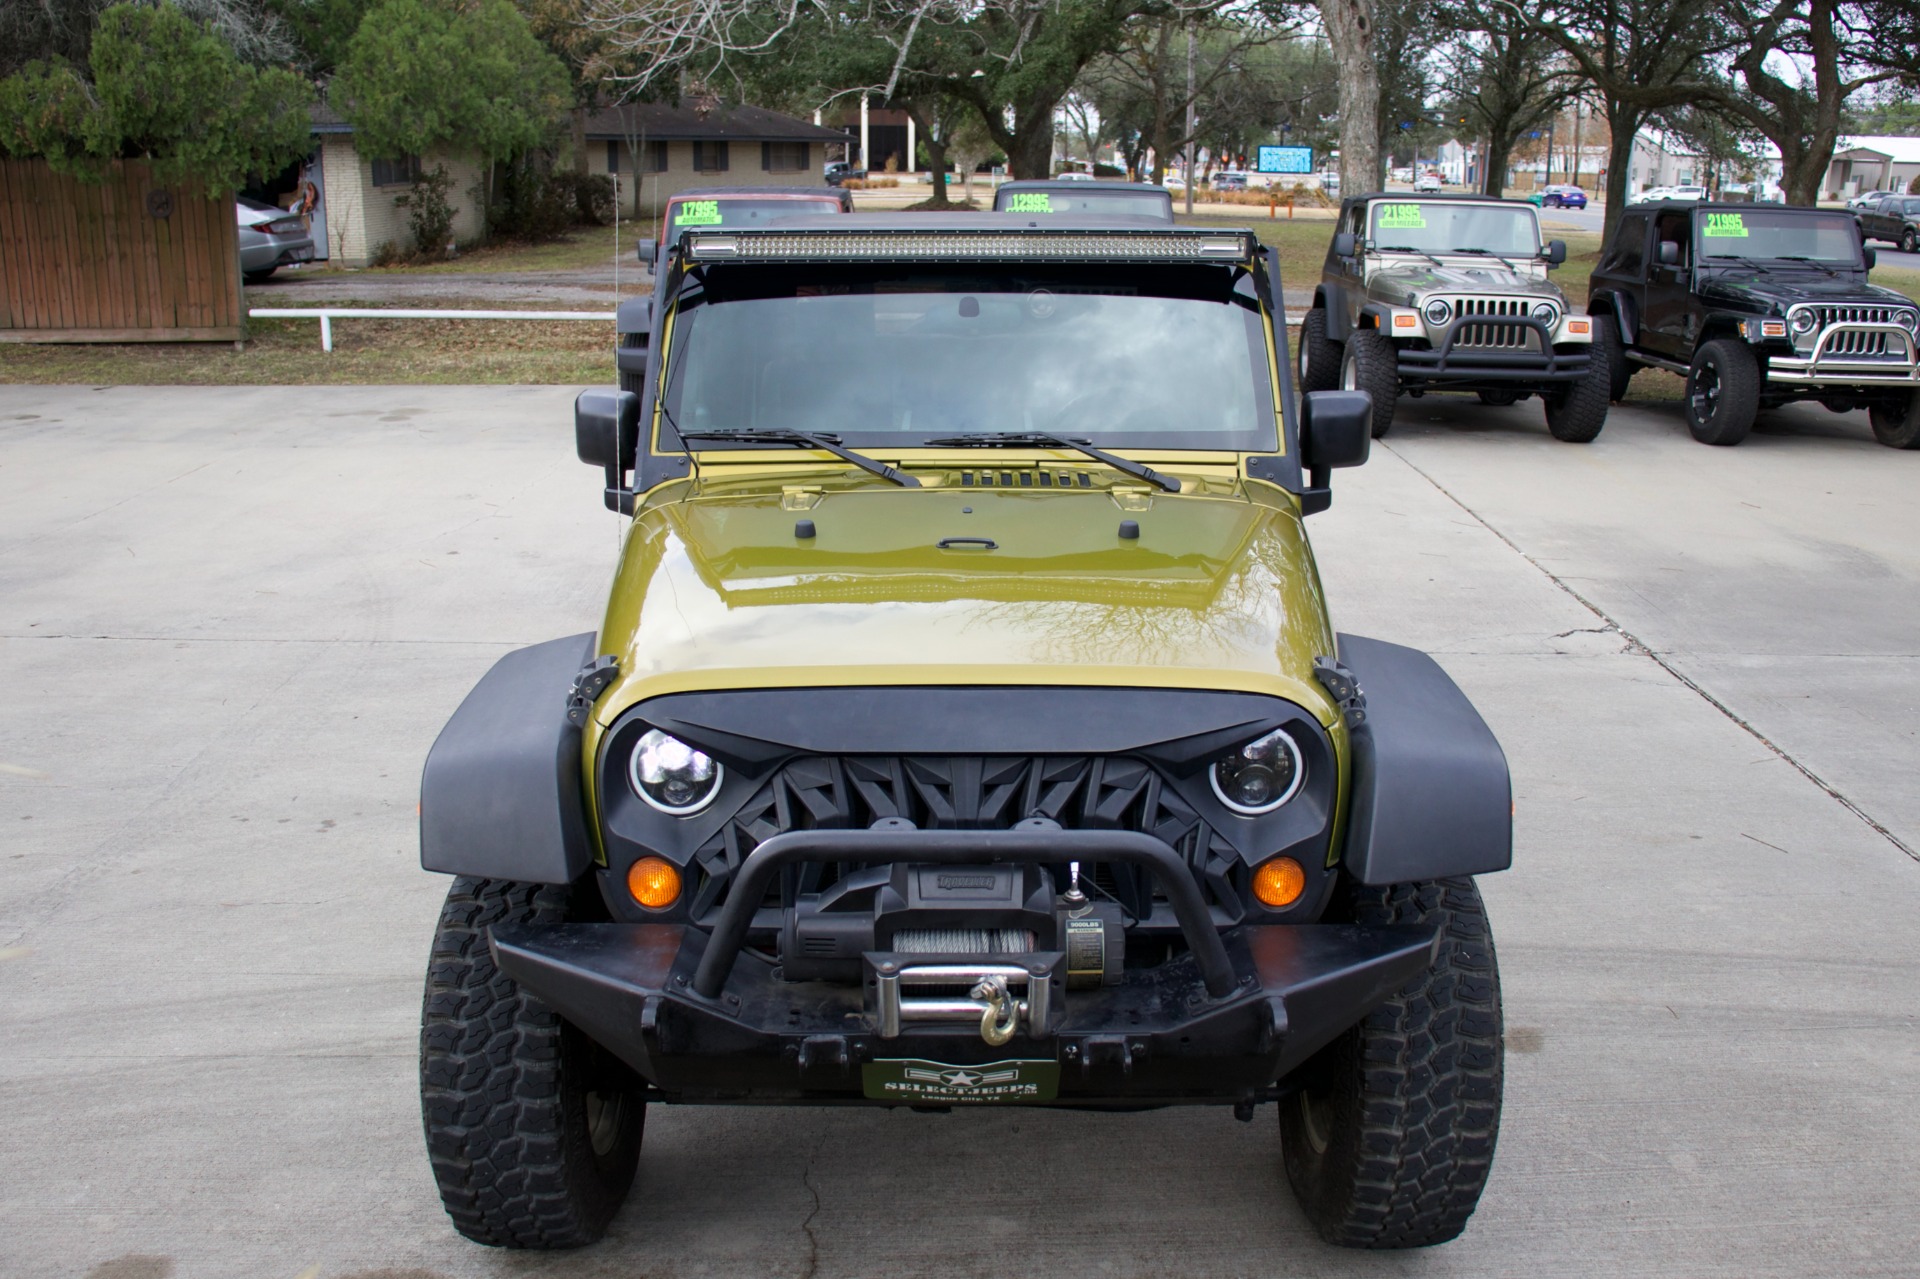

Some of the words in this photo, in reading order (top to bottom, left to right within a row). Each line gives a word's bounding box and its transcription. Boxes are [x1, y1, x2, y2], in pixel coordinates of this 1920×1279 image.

[1012, 193, 1049, 208] 12995
[682, 201, 718, 217] 17995
[1383, 204, 1420, 220] 21995
[682, 216, 715, 224] AUTOMATIC
[1707, 213, 1743, 229] 21995
[1710, 228, 1742, 236] AUTOMATIC
